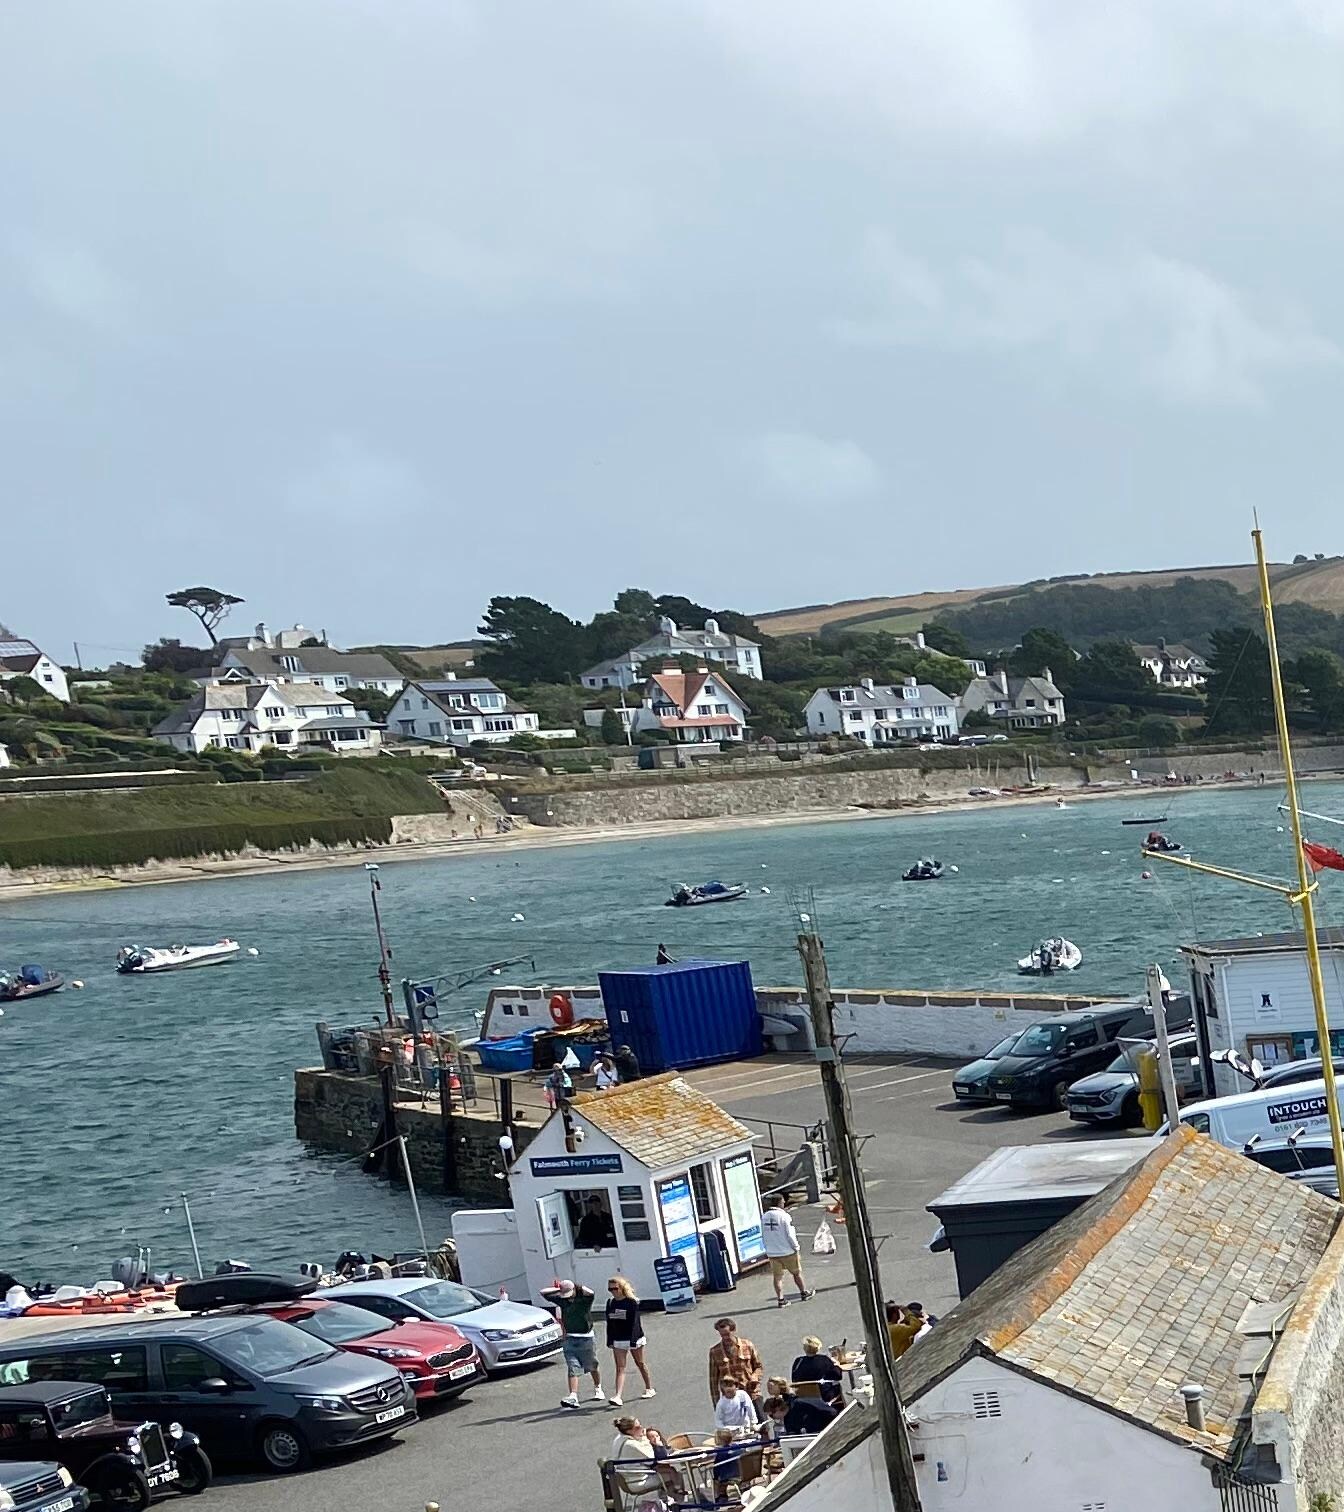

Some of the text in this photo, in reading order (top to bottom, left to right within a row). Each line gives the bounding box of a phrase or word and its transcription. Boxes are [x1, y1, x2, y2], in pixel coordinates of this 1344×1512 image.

[1269, 1099, 1327, 1116] INTOUCH
[533, 1158, 619, 1169] Falmouth Ferry Tickets
